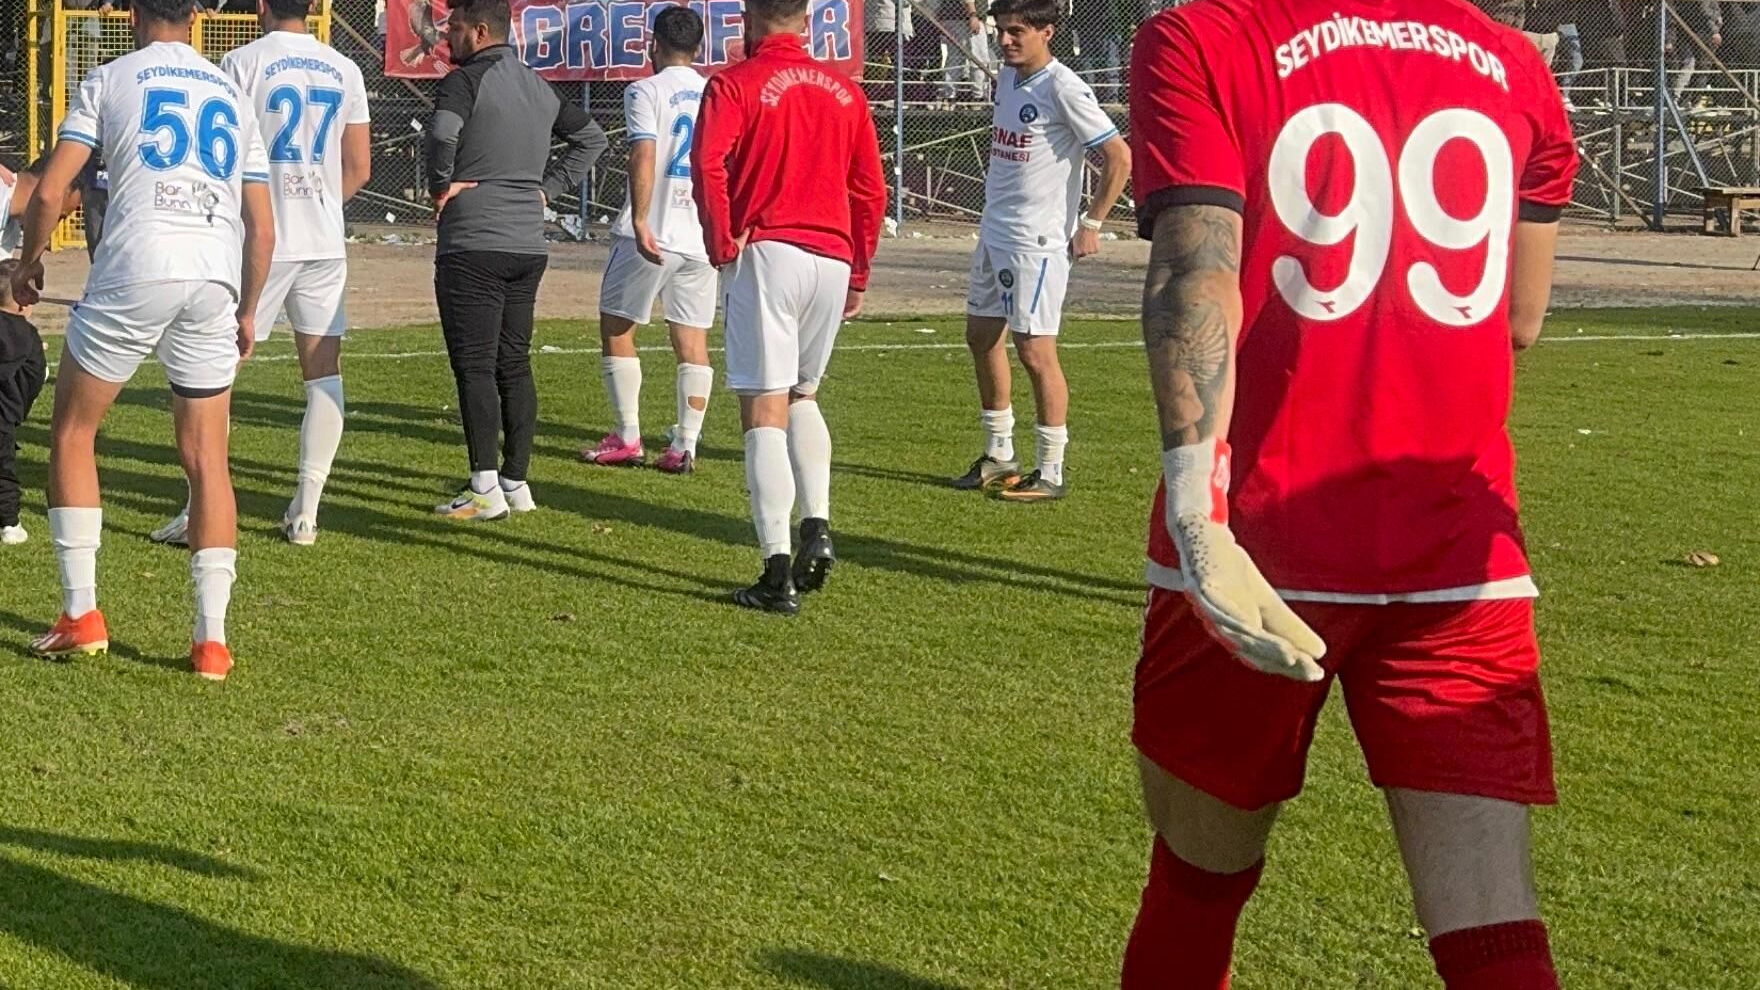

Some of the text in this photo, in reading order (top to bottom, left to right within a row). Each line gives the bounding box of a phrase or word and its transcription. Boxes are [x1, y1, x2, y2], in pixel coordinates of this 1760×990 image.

[1275, 12, 1509, 92] SEYDİKEMERSPOR
[138, 86, 241, 181] 56
[265, 83, 346, 165] 27
[665, 112, 695, 178] 2
[993, 126, 1033, 148] SNAF
[155, 181, 182, 196] Bar
[1268, 103, 1514, 327] 99
